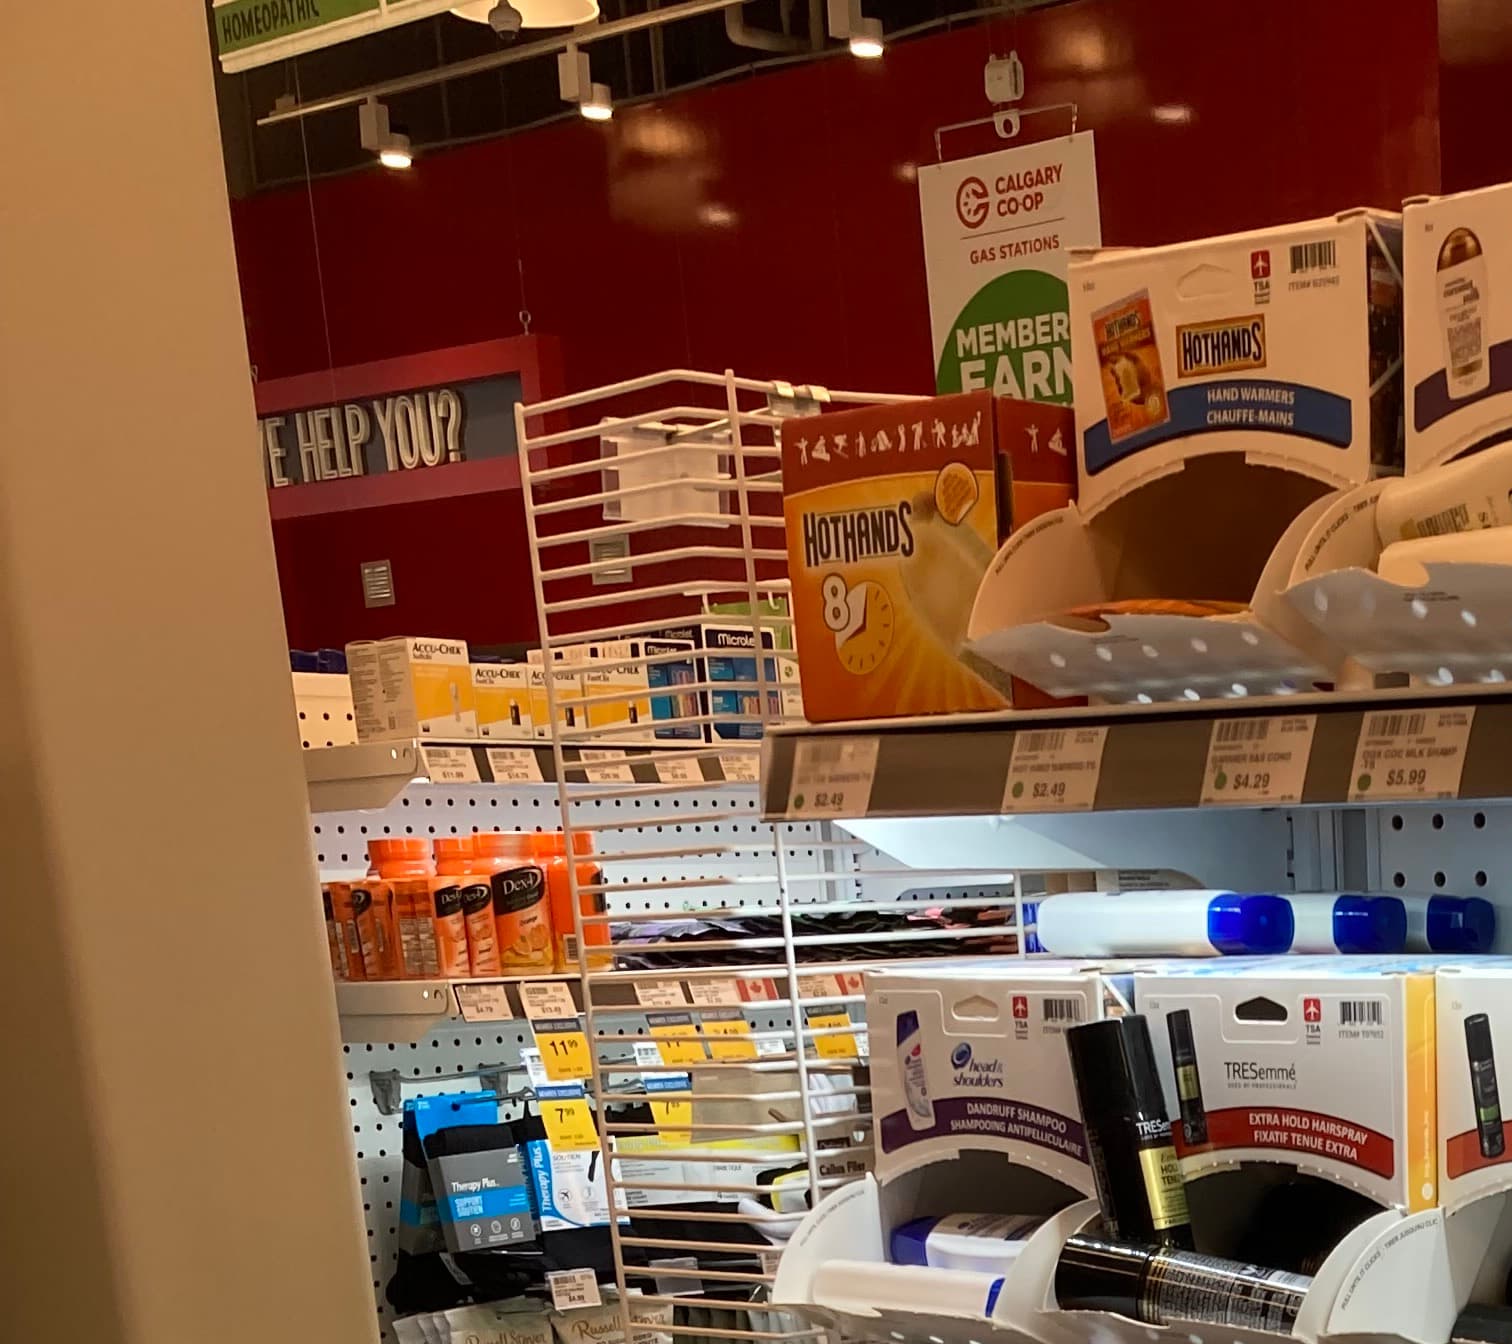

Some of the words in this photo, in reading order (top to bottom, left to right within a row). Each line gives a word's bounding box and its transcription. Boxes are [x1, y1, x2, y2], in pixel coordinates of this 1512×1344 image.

[222, 0, 320, 43] HOMEOPATHIC
[996, 164, 1062, 194] CALGARY
[970, 247, 995, 264] GAS
[1000, 235, 1059, 259] STATIONS
[1182, 322, 1262, 370] HOTHANDS
[1207, 389, 1238, 403] HAND
[1241, 389, 1295, 406] WARMERS
[1206, 410, 1294, 426] CHAUFFE-MAINS
[296, 405, 370, 482] HELP
[373, 389, 461, 471] YOU?
[803, 501, 914, 567] HOTHANDS
[822, 573, 850, 632] 8
[413, 643, 462, 655] ACCU-CHEK
[475, 668, 521, 679] ACCU-CHEK
[1233, 773, 1269, 789] $4.29
[1387, 768, 1426, 786] $5.99
[1033, 783, 1065, 798] $2.49
[969, 1058, 996, 1073] head
[1224, 1062, 1297, 1081] TRESemmé
[953, 1073, 1003, 1088] shoulders
[967, 1103, 1015, 1119] DANDRUFF
[1017, 1108, 1067, 1133] SHAMPOO
[1249, 1113, 1279, 1127] EXTRA
[1282, 1115, 1309, 1130] HOLD
[1312, 1120, 1367, 1145] HAIRSPRAY
[951, 1120, 1005, 1134] SHAMPOOING
[1007, 1123, 1082, 1156] ANTIPELLICULAIRE
[1254, 1130, 1288, 1144] FIXATIF
[1291, 1134, 1323, 1151] TENUE
[1325, 1142, 1357, 1161] EXTRA
[533, 1147, 542, 1169] Plus
[452, 1181, 481, 1193] Therapy
[482, 1177, 497, 1188] Plus
[536, 1173, 552, 1212] Therapy
[572, 1317, 621, 1340] Russell
